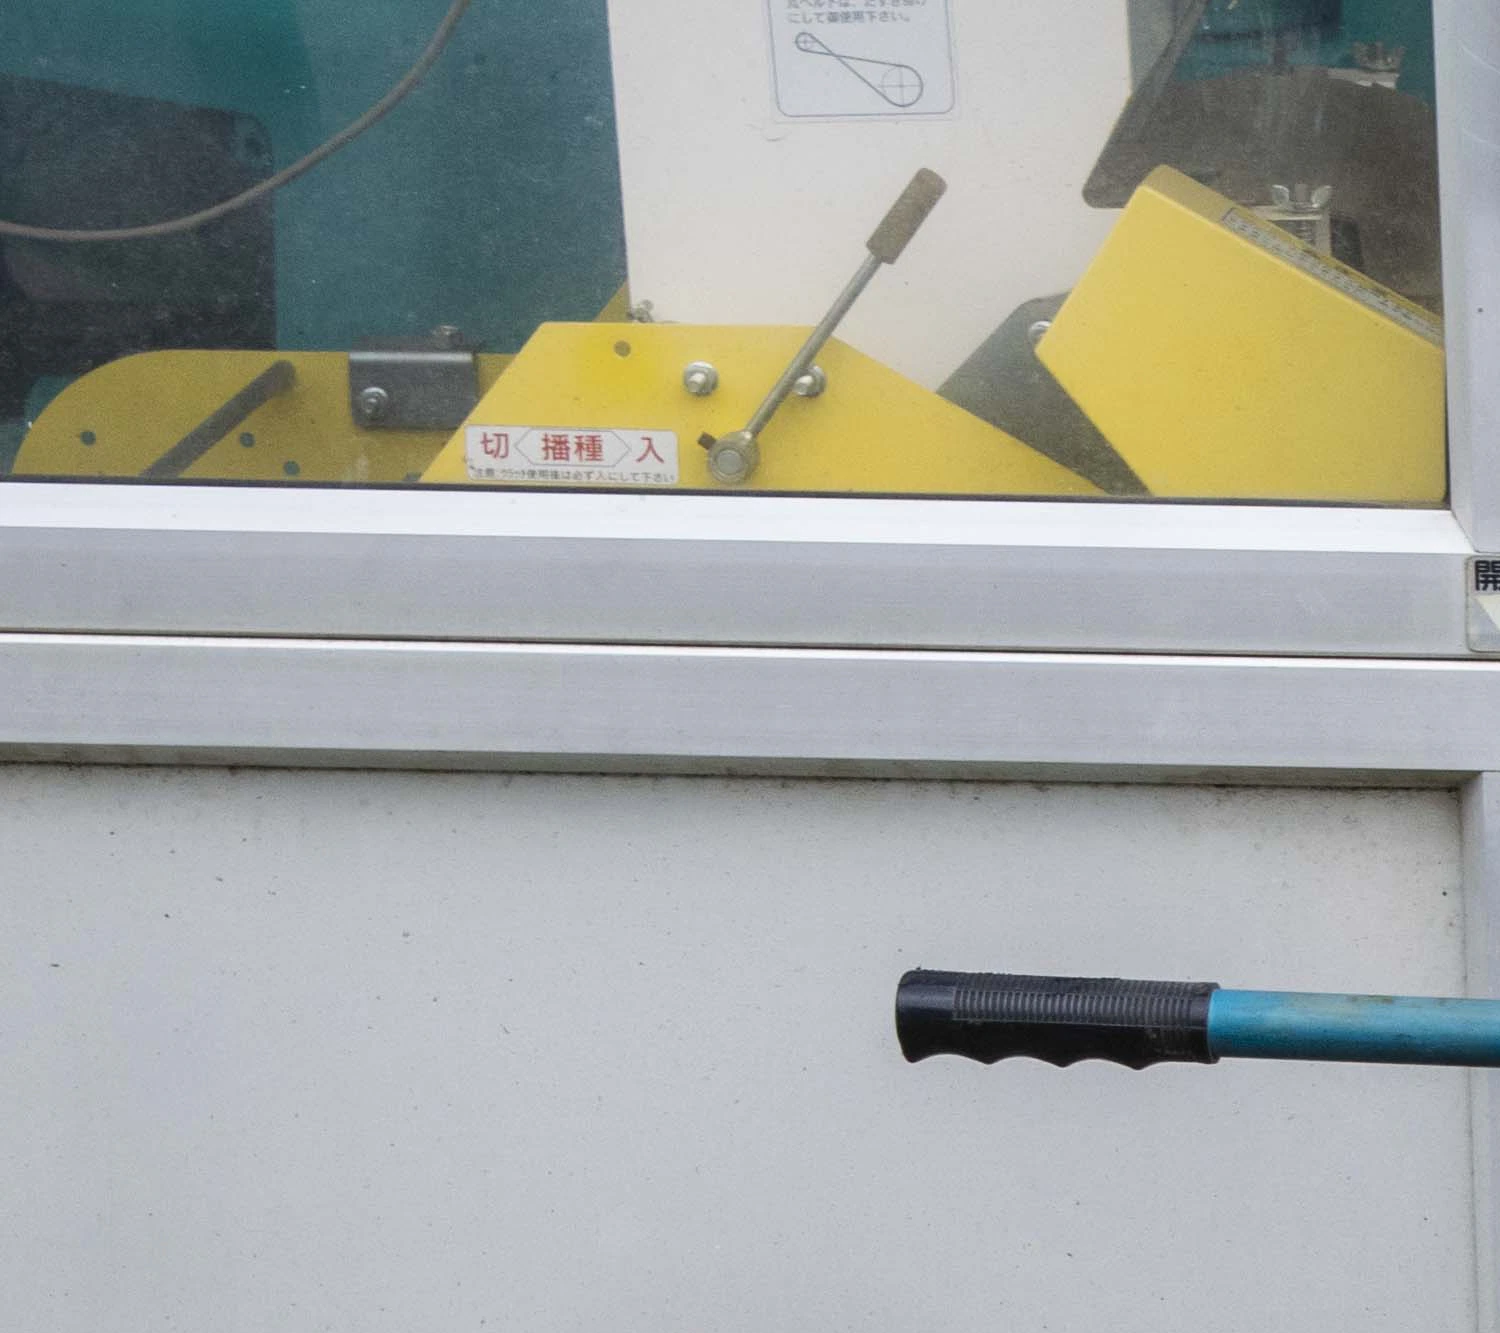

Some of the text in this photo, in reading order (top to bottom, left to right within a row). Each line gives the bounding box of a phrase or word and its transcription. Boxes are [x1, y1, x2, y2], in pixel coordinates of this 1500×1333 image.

[480, 432, 665, 464] 切 播種 入
